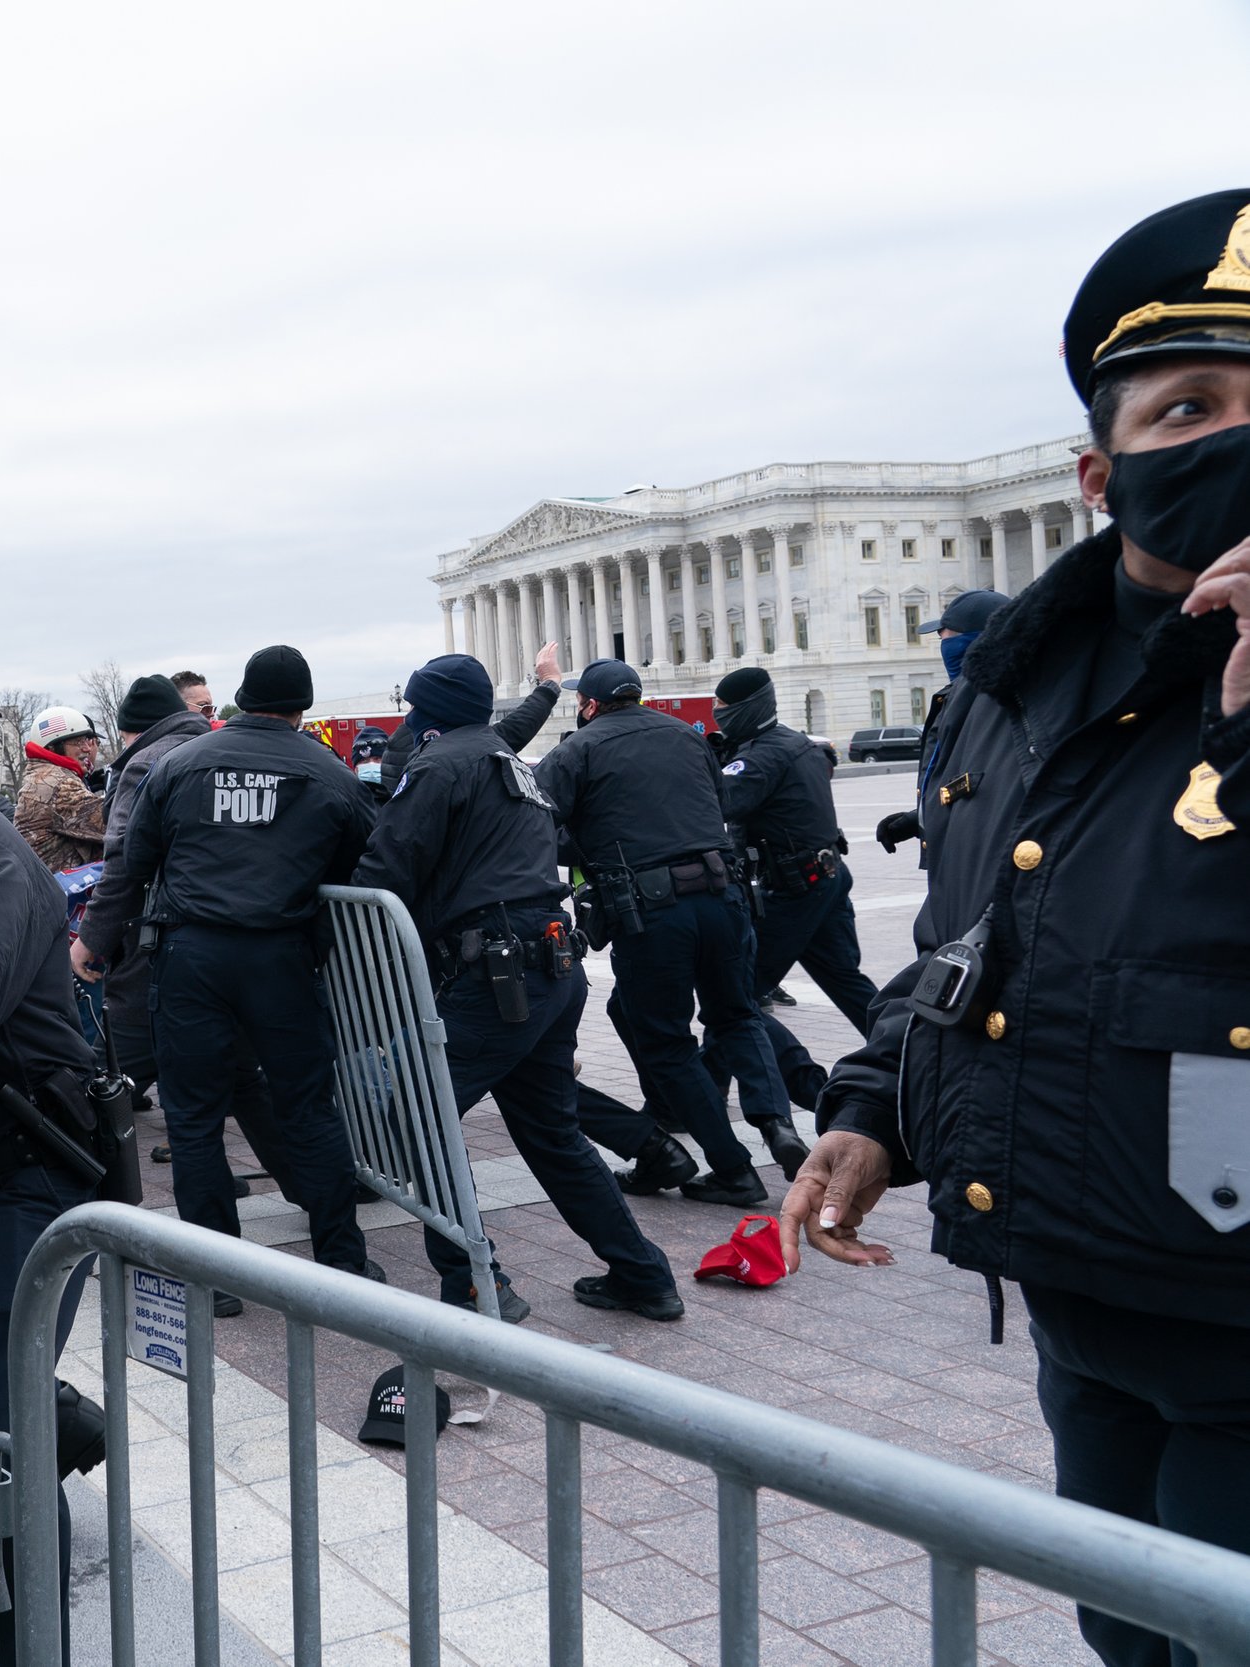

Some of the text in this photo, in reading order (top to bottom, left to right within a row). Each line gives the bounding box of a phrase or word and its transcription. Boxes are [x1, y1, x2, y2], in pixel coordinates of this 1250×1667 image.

[214, 772, 241, 788] U.S.
[213, 788, 277, 823] POLI
[135, 1270, 186, 1302] LONG FENCE
[135, 1294, 160, 1307] COMMERCIAL
[135, 1306, 186, 1330] 888-887-566
[380, 1404, 405, 1415] AMERI
